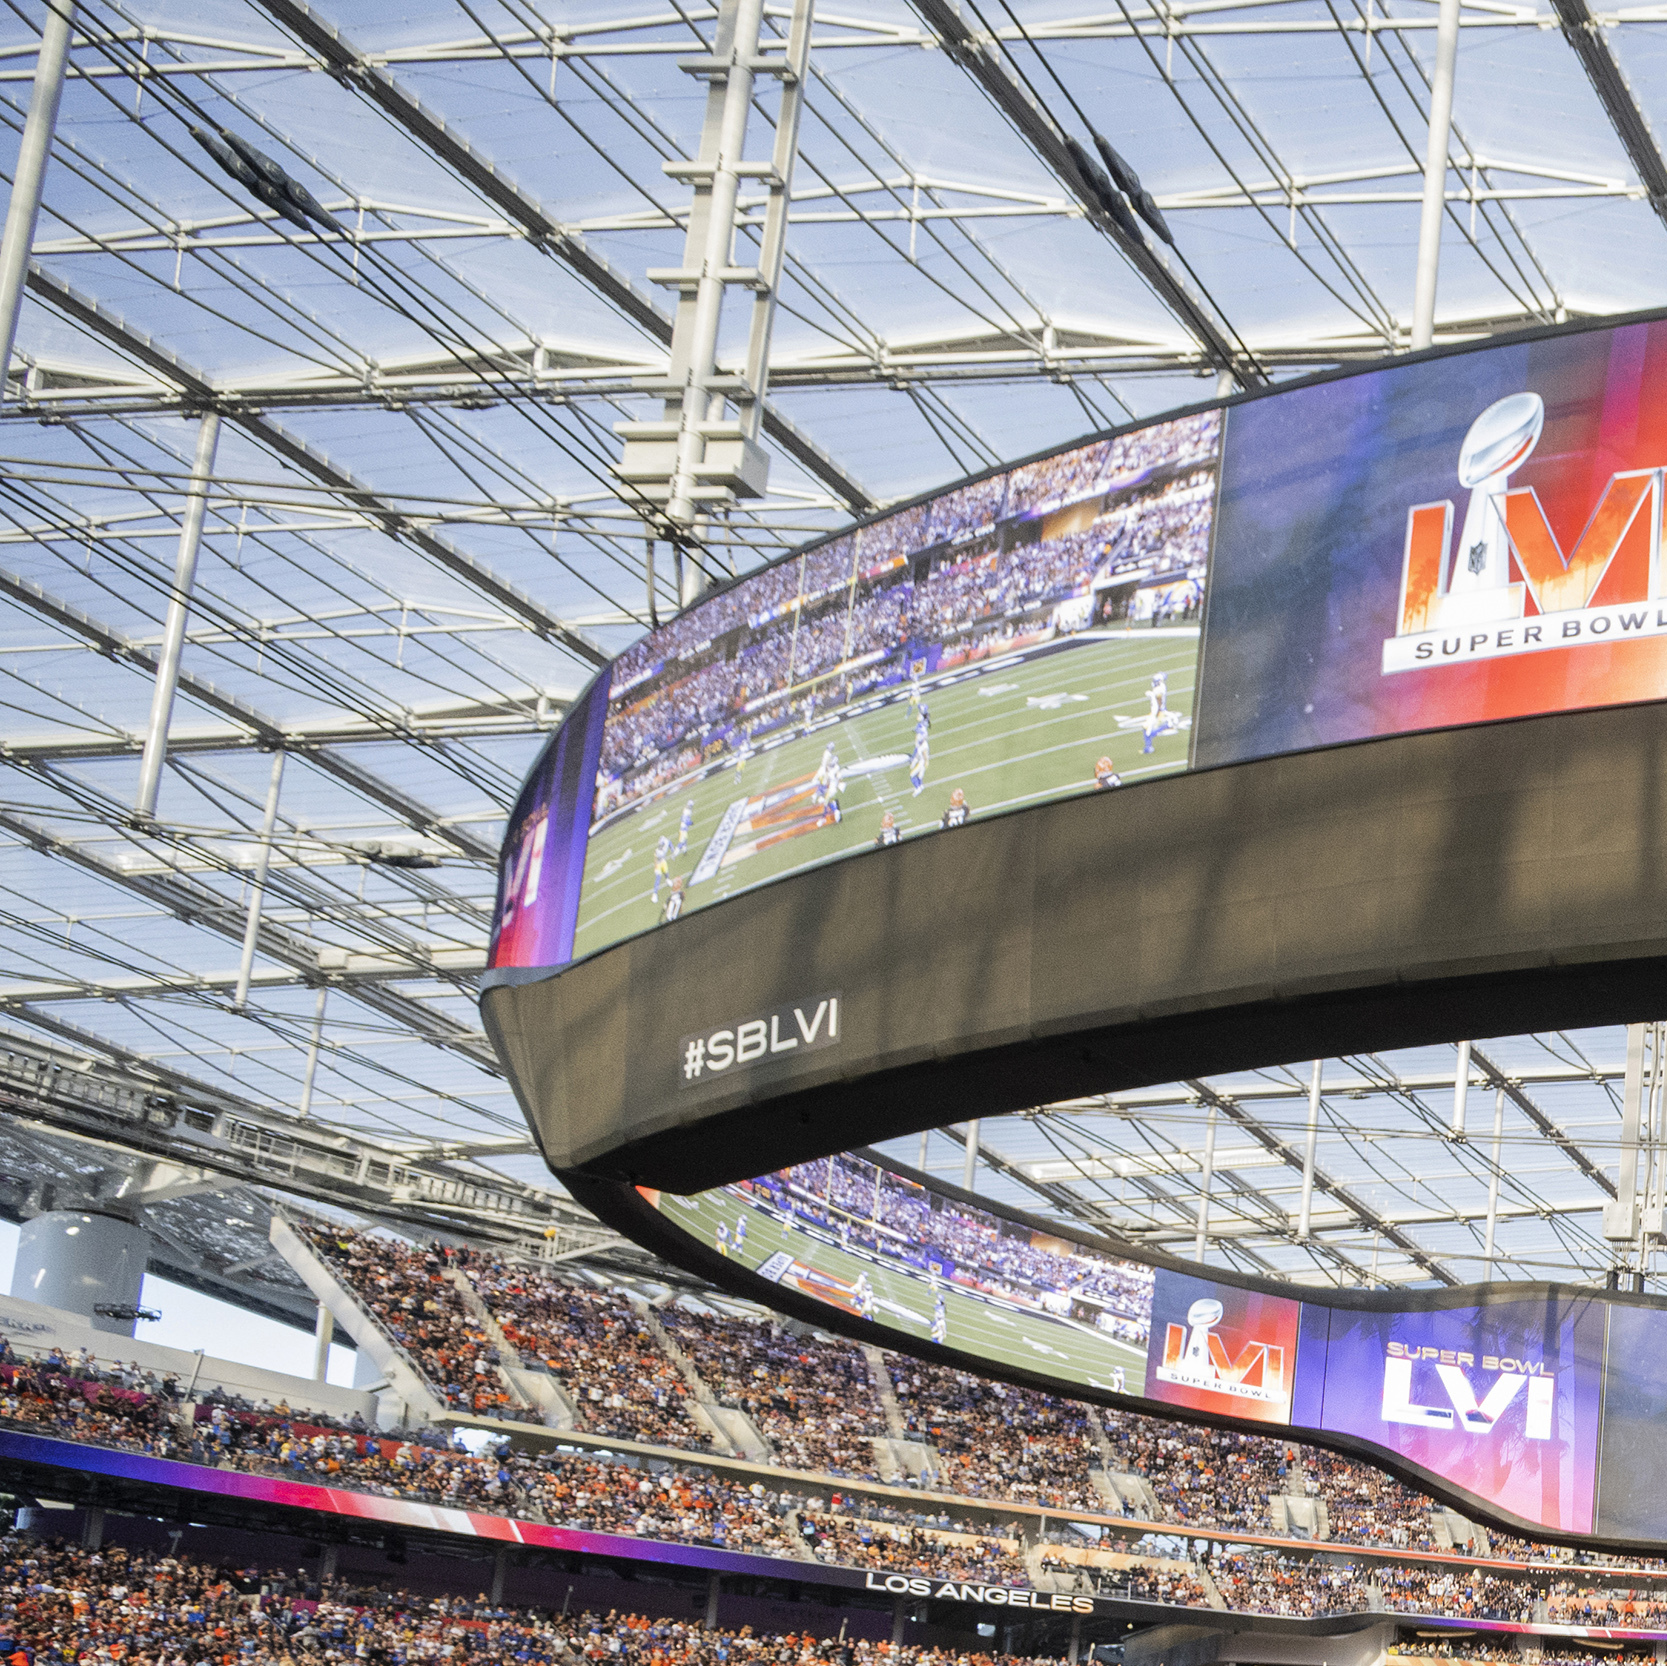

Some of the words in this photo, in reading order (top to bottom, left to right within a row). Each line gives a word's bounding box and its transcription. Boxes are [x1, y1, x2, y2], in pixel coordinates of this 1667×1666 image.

[1415, 625, 1544, 661] SUPER
[683, 997, 837, 1080] #SBLVI
[1387, 1341, 1474, 1367] SUPER
[1482, 1355, 1555, 1377] BOWL
[1170, 1373, 1222, 1391] SUPER
[1229, 1384, 1272, 1399] BOWL
[1381, 1357, 1554, 1440] LVI
[866, 1572, 932, 1597] LOS
[934, 1582, 1095, 1614] ANGELES
